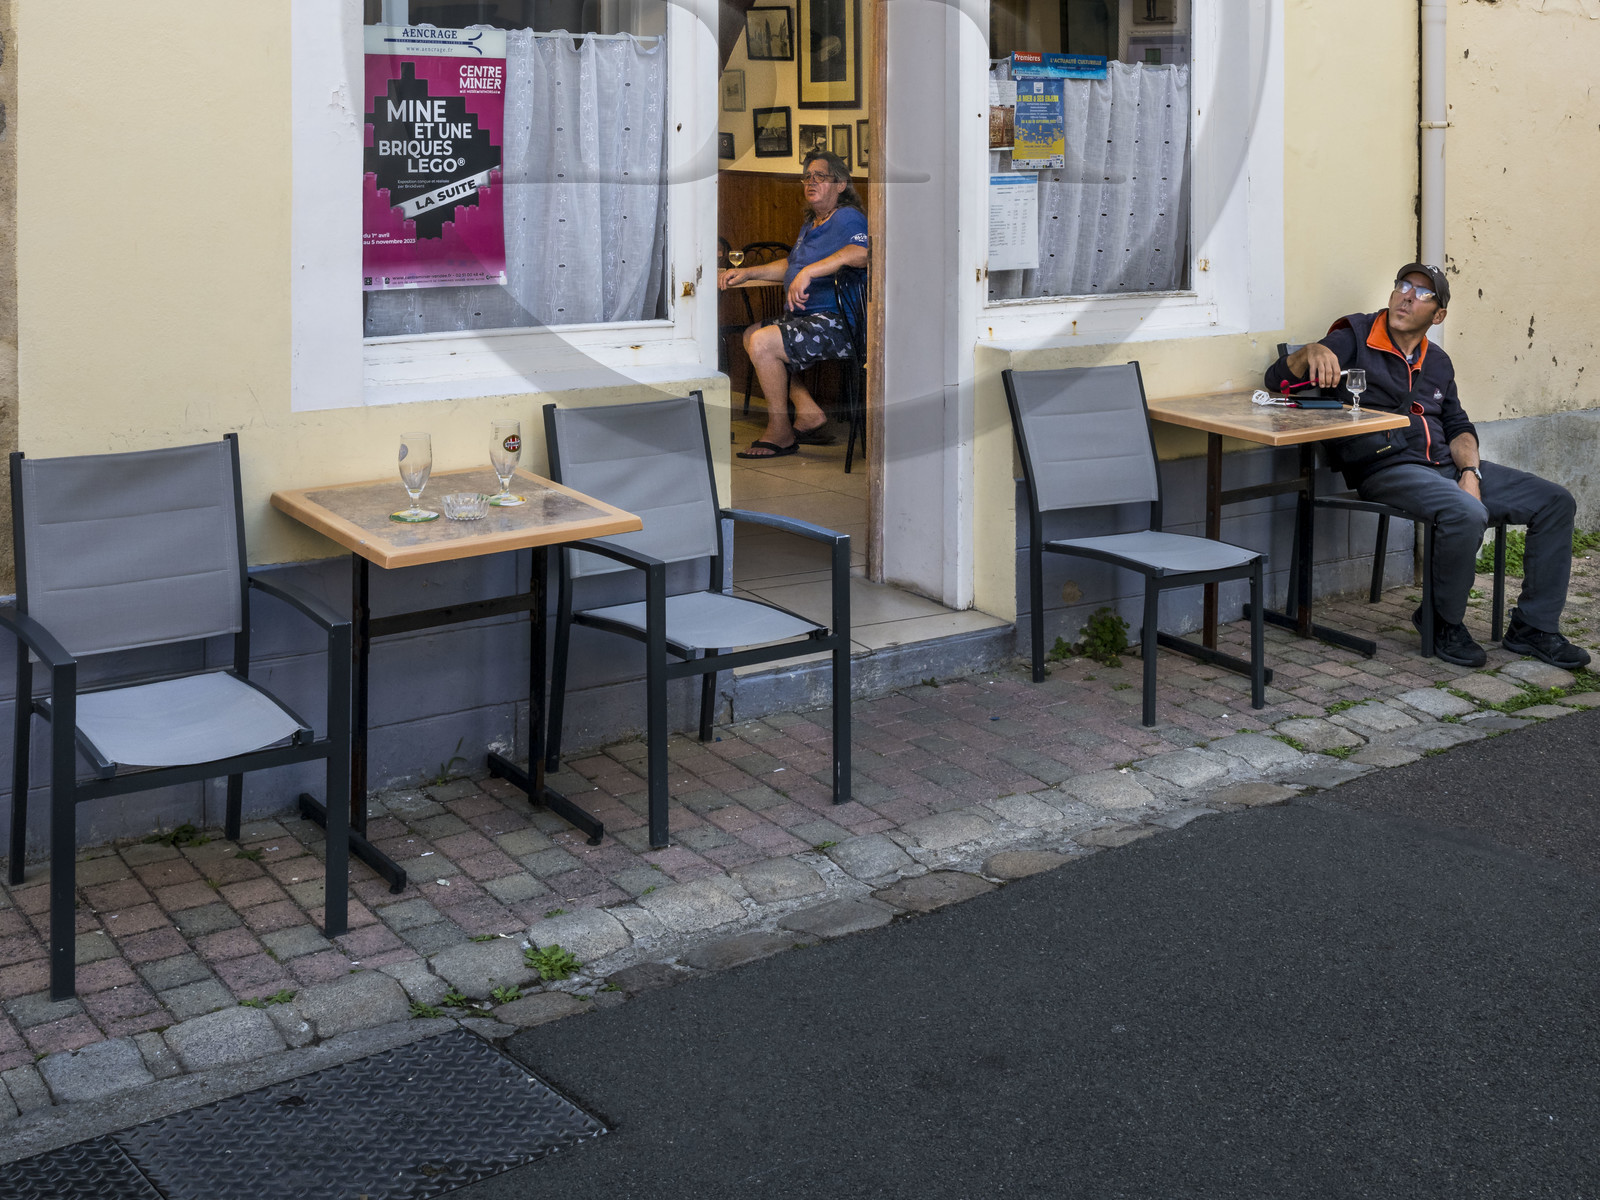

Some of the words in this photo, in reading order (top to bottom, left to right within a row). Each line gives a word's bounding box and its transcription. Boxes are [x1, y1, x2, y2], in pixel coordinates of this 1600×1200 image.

[402, 29, 457, 39] AENCRAGE
[459, 65, 502, 78] CENTRE
[460, 78, 501, 89] MINIER
[387, 100, 446, 122] MINE
[415, 123, 434, 138] ET
[439, 123, 472, 138] UNE
[379, 141, 453, 158] BRIQUES
[416, 197, 435, 210] LA
[438, 179, 476, 202] SUITE
